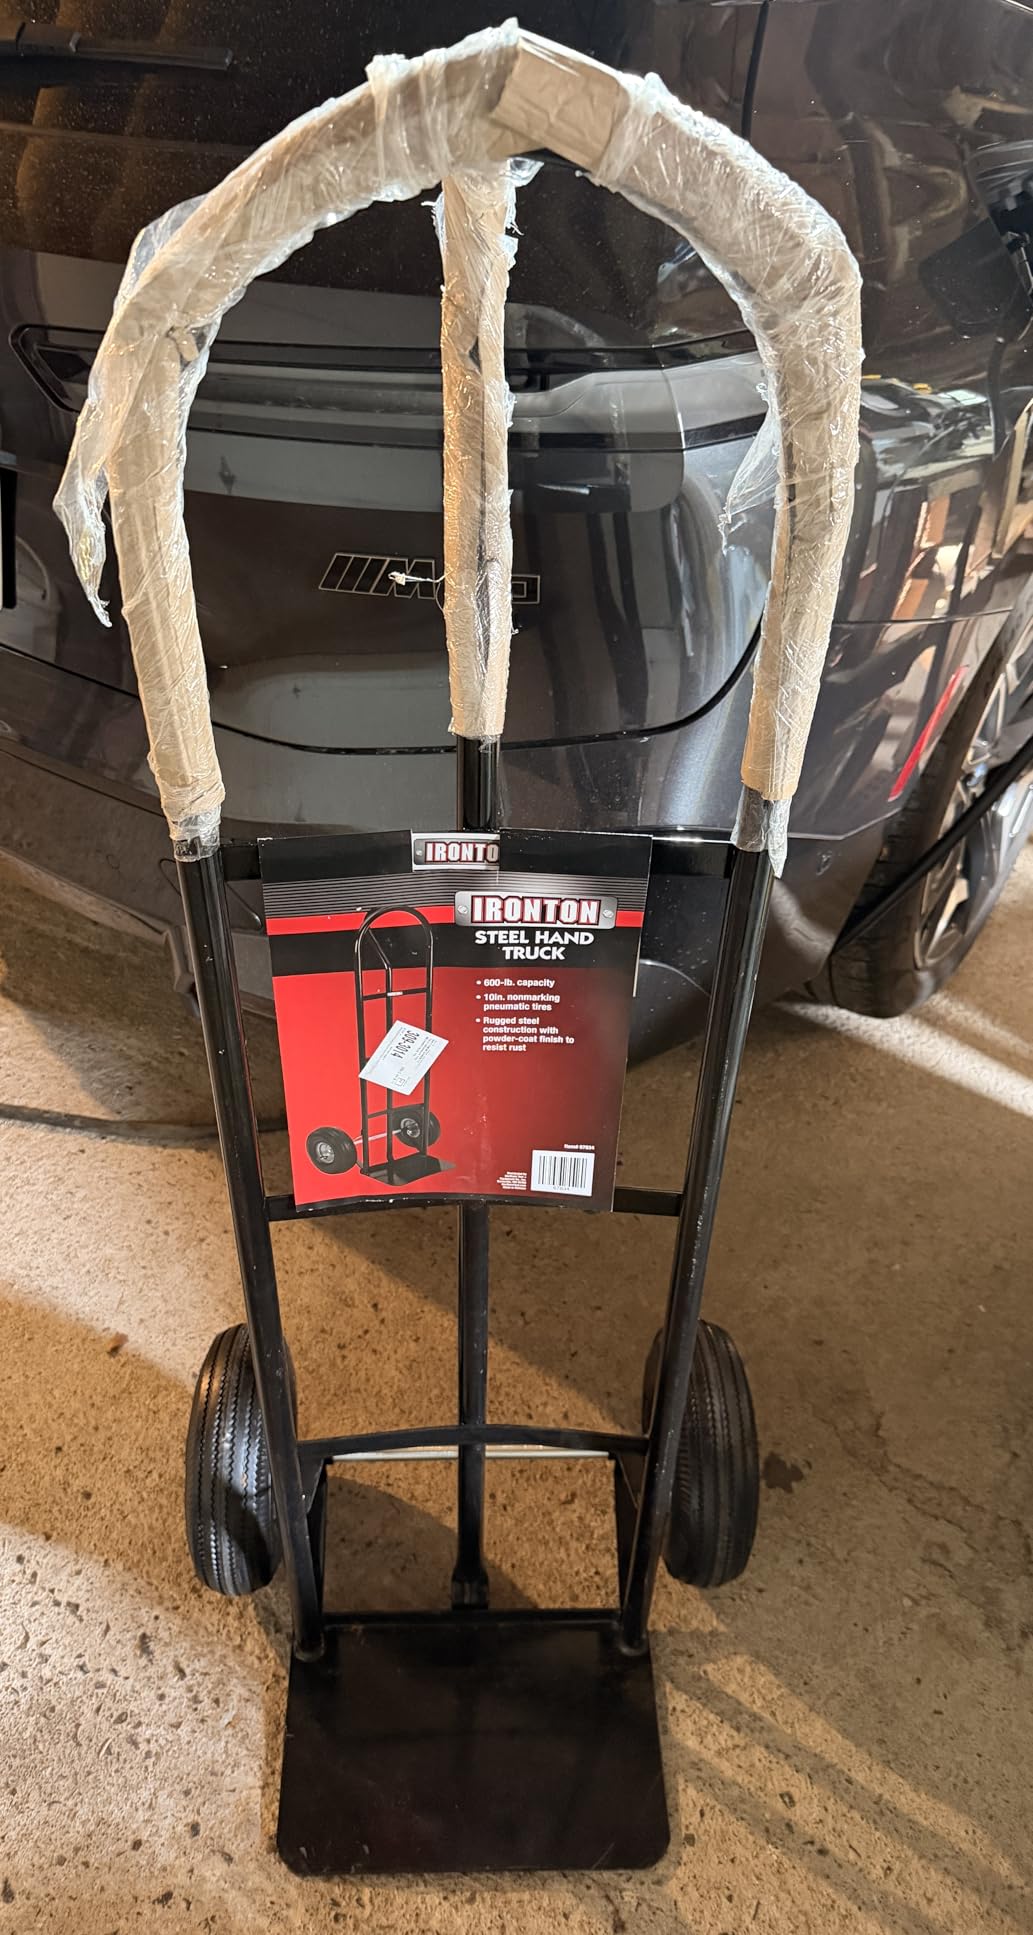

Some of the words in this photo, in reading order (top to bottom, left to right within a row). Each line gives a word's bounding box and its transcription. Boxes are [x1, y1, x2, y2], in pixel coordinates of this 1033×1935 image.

[425, 842, 500, 863] IRONTO
[471, 895, 601, 926] IRONTON
[475, 930, 529, 944] STEEL
[535, 931, 594, 945] HAND
[502, 946, 565, 960] TRUCK
[484, 978, 515, 987] 600-lb.
[517, 978, 555, 988] capacity
[484, 993, 505, 1001] 10in.
[507, 993, 560, 1003] nonmarking
[483, 1002, 530, 1011] pneumatic
[532, 1003, 552, 1011] tires
[483, 1016, 516, 1025] Rugged
[483, 1026, 537, 1034] construction
[539, 1026, 558, 1034] with
[391, 1030, 420, 1059] 309-3014
[483, 1035, 537, 1043] powder-coat
[566, 1036, 575, 1044] to
